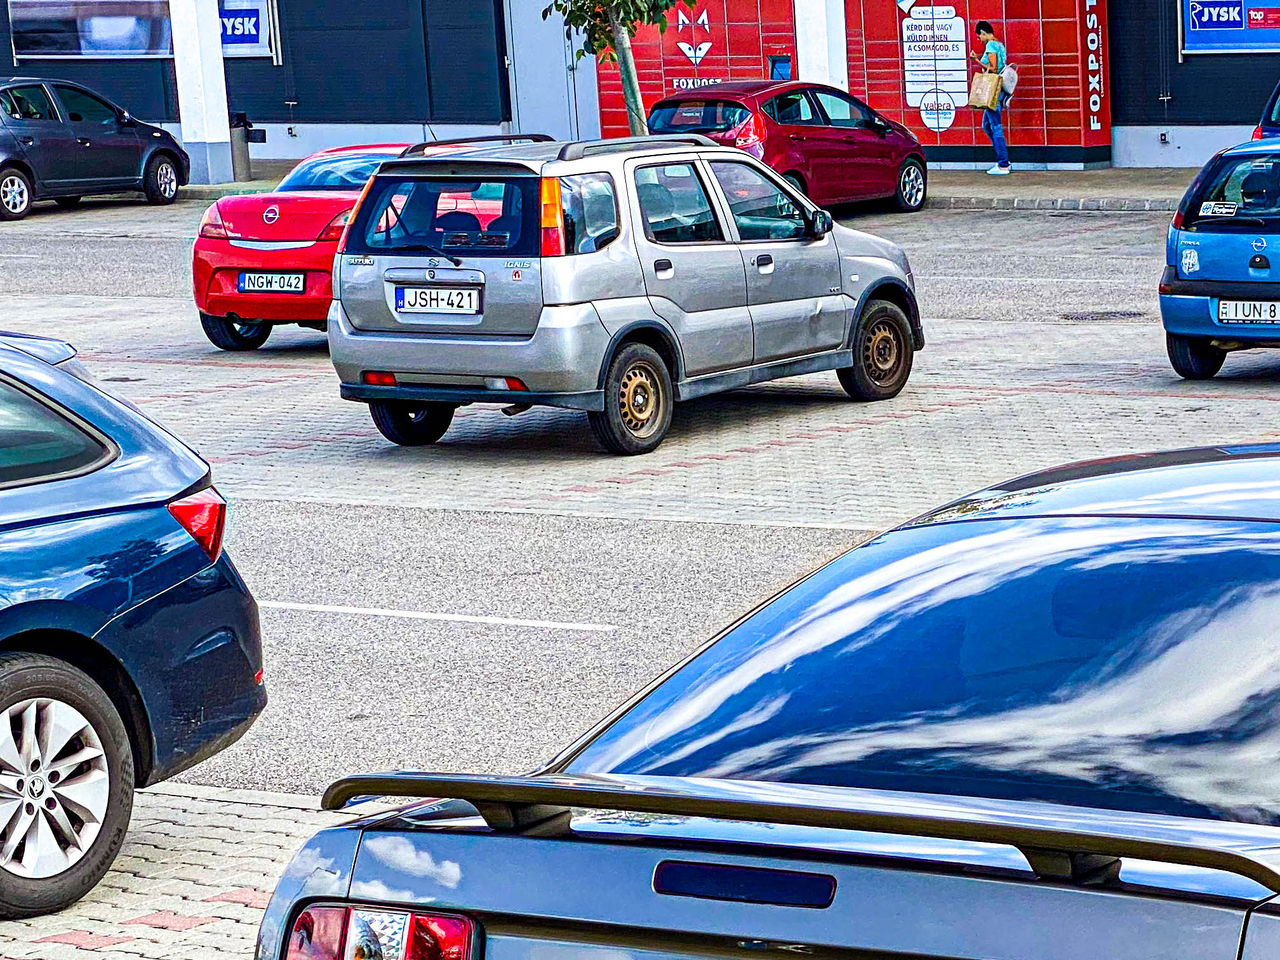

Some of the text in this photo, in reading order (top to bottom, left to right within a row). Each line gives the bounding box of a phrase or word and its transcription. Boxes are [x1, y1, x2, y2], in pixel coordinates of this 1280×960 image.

[1201, 6, 1241, 22] JYSK
[1249, 10, 1264, 20] top
[220, 17, 257, 36] YSK
[906, 23, 923, 31] KÉRD
[951, 43, 960, 52] ÉS
[1085, 0, 1101, 131] FOXPOST
[247, 275, 301, 289] NGW-042
[407, 290, 472, 309] JSH-421
